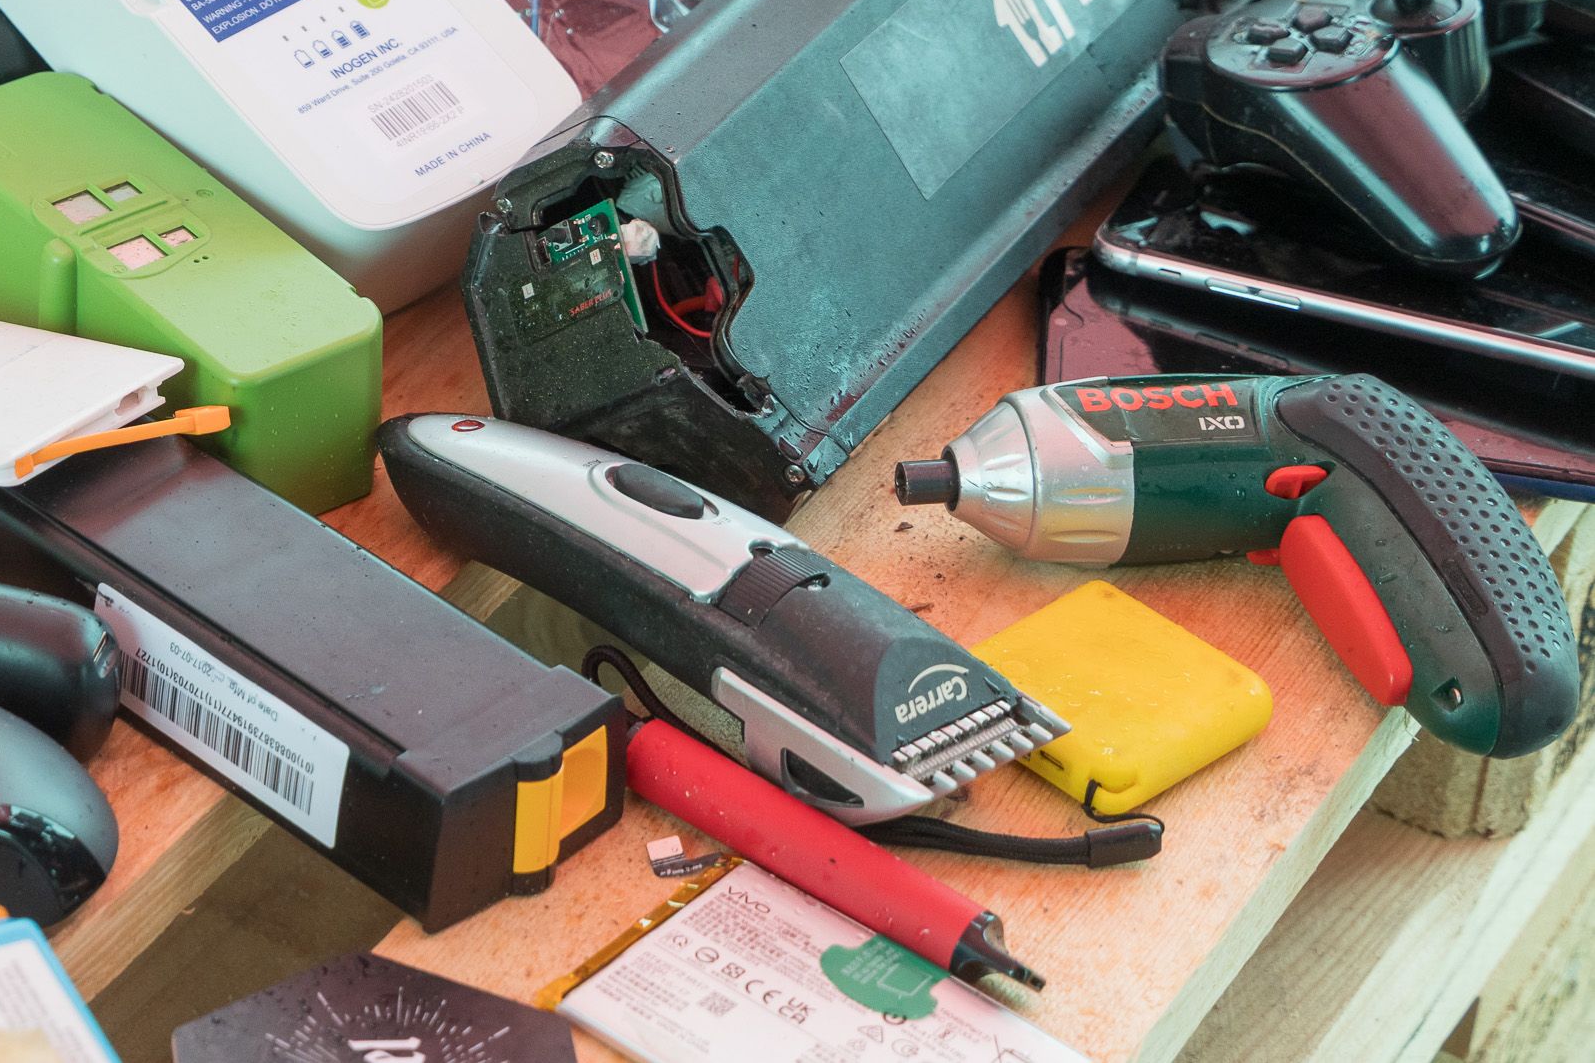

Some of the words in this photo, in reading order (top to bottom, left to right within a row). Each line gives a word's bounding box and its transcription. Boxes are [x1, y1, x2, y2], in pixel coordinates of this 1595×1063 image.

[201, 0, 243, 24] WARNING
[296, 102, 314, 115] 859
[310, 91, 333, 107] Ward
[350, 71, 372, 86] Suite
[368, 64, 385, 77] 200
[406, 44, 423, 56] CA
[439, 25, 459, 39] USA
[328, 48, 379, 80] INOGEN
[375, 36, 403, 55] INC.
[413, 155, 447, 177] MADE
[443, 148, 459, 160] IN
[456, 130, 492, 153] CHINA
[1075, 383, 1239, 413] BOSCH
[1198, 415, 1245, 431] IXO
[169, 639, 212, 677] 2017-07-03
[135, 643, 315, 776] (01)00883873919477(11)170703(10)1727
[246, 692, 256, 707] of
[257, 699, 278, 722] Date
[894, 675, 968, 724] Carrera
[723, 883, 775, 915] vivo
